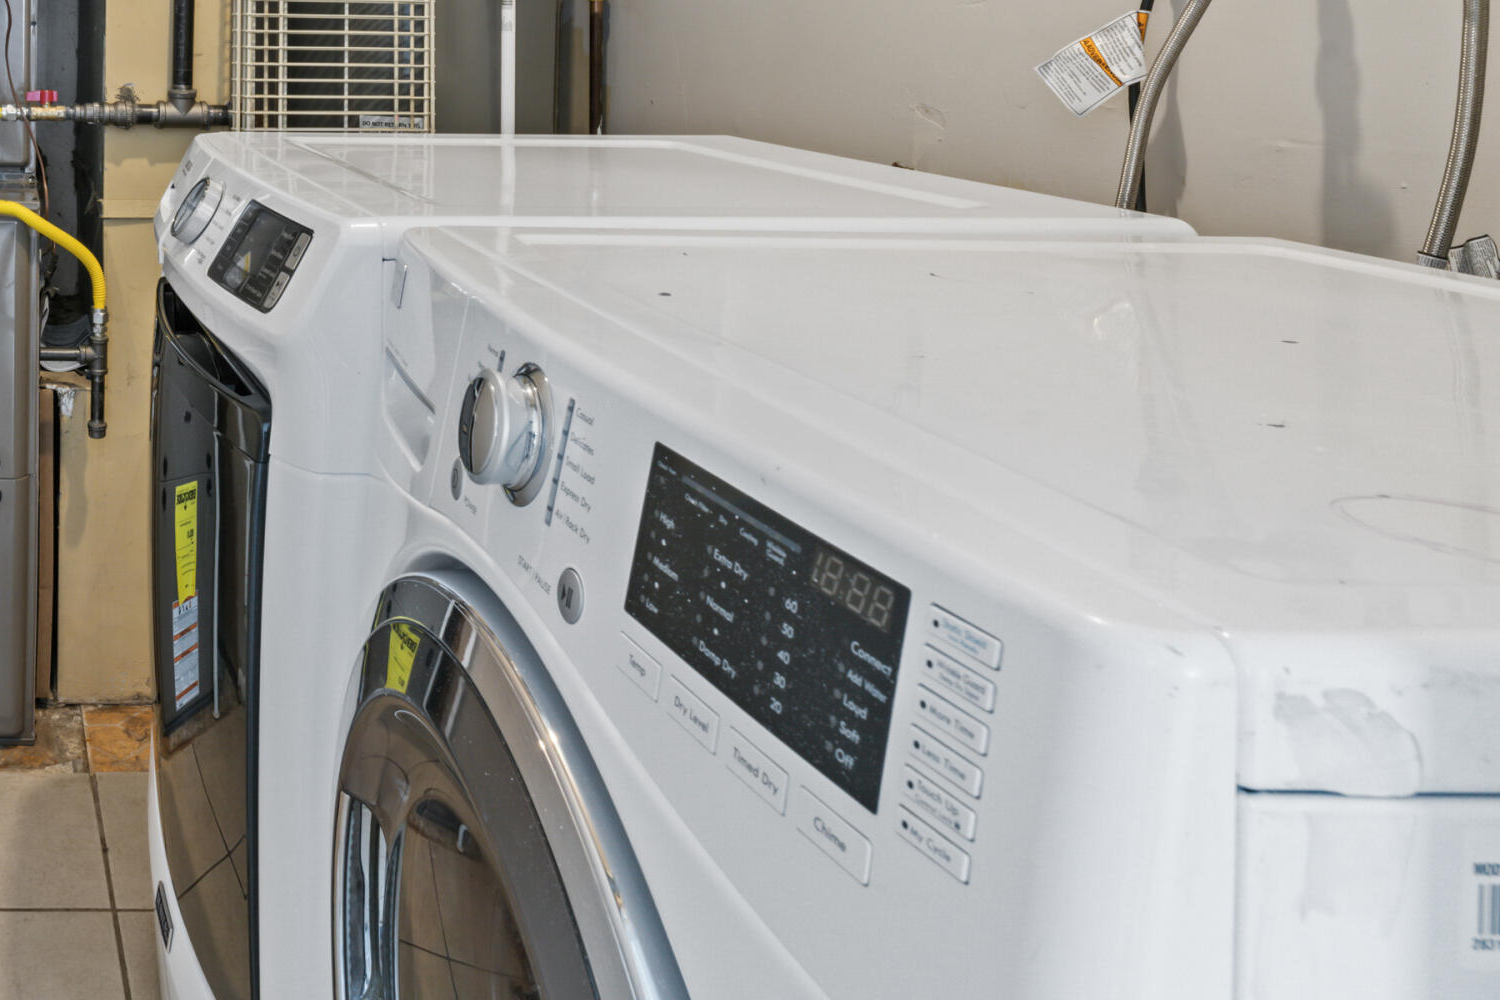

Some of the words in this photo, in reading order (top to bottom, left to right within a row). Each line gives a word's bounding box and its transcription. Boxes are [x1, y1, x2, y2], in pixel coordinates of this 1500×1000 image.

[580, 496, 591, 513] Dry
[713, 548, 733, 570] Extra
[734, 561, 749, 582] Dry
[706, 595, 734, 623] Normal
[781, 622, 795, 639] 50
[629, 654, 646, 677] Temp
[699, 639, 722, 667] Damp
[721, 658, 737, 680] Dry
[776, 650, 791, 665] 40
[850, 640, 893, 677] Connect
[773, 671, 787, 689] 30
[674, 695, 688, 717] Dry
[689, 710, 709, 733] Level
[770, 696, 783, 715] 20
[842, 693, 869, 720] Loud
[838, 720, 861, 745] Soft
[733, 746, 759, 779] Timed
[761, 771, 779, 797] Dry
[834, 748, 855, 770] Off
[813, 816, 847, 853] Chime
